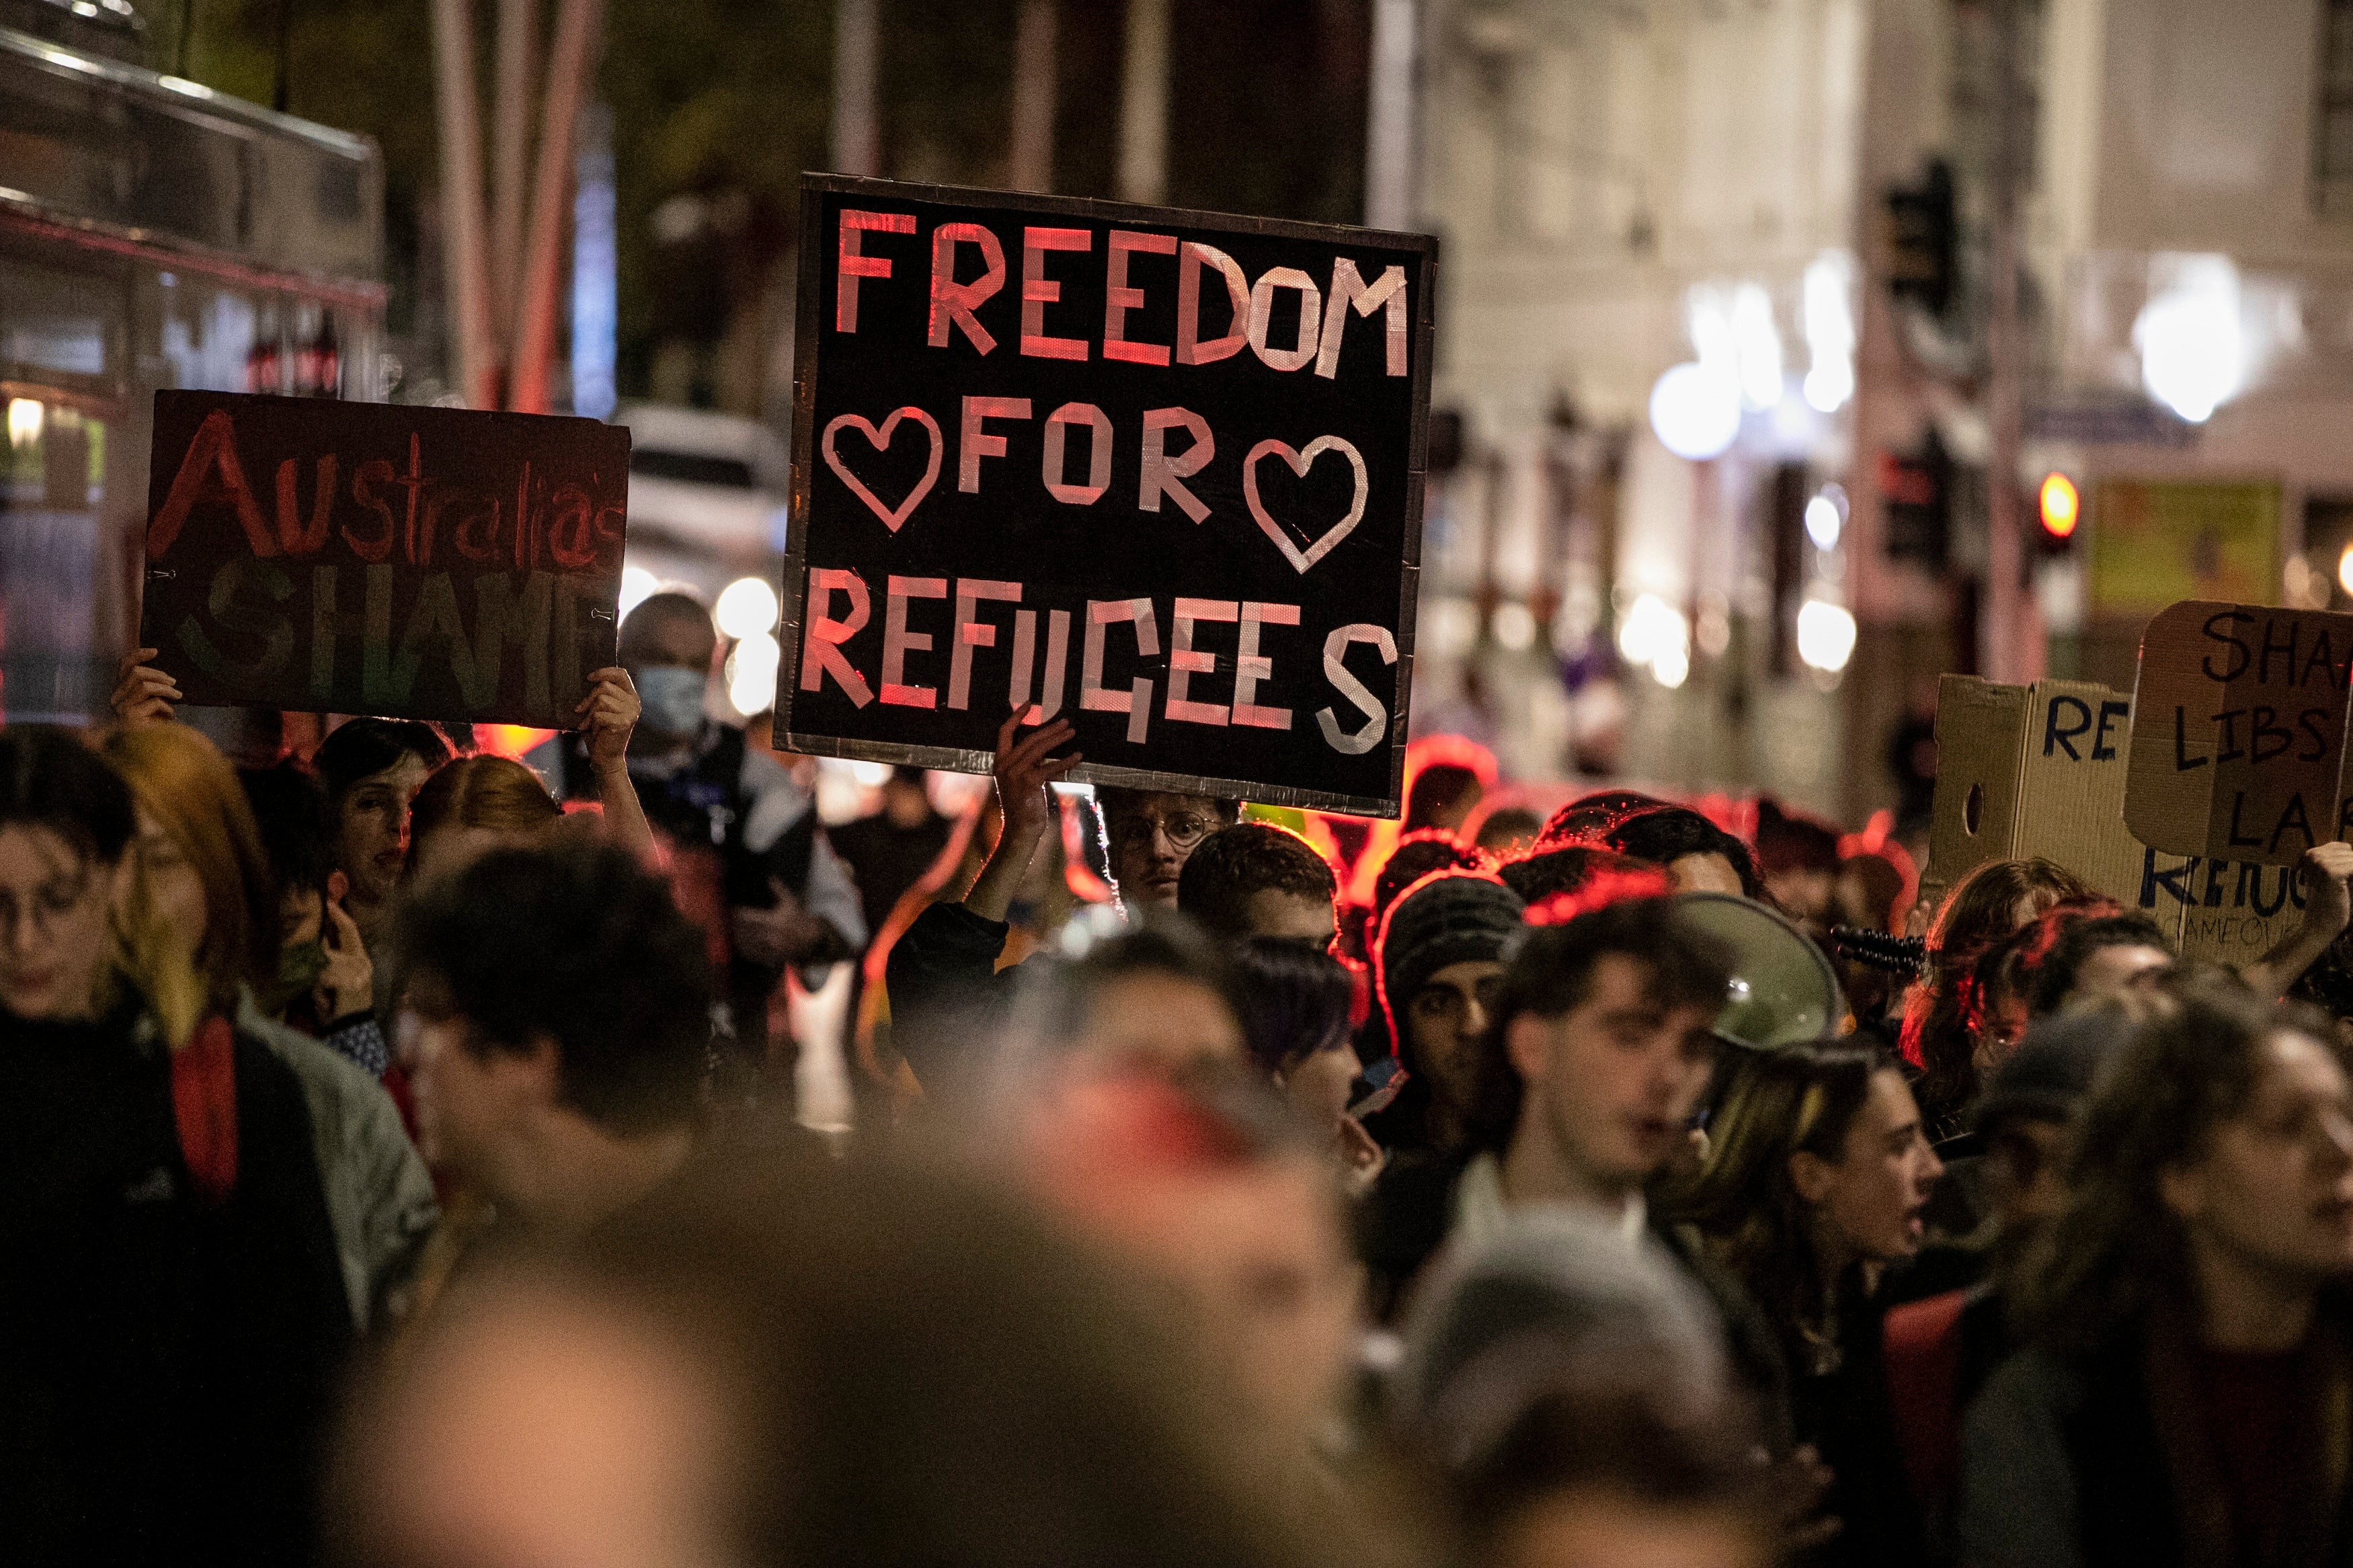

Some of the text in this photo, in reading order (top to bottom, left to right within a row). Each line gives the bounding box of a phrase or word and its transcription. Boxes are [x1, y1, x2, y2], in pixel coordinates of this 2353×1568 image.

[836, 209, 1408, 379] FREEDOM
[958, 395, 1215, 524] FOR
[799, 567, 1398, 755] REFUGEES
[2202, 612, 2353, 690] SHA
[2175, 705, 2330, 772] LIBS
